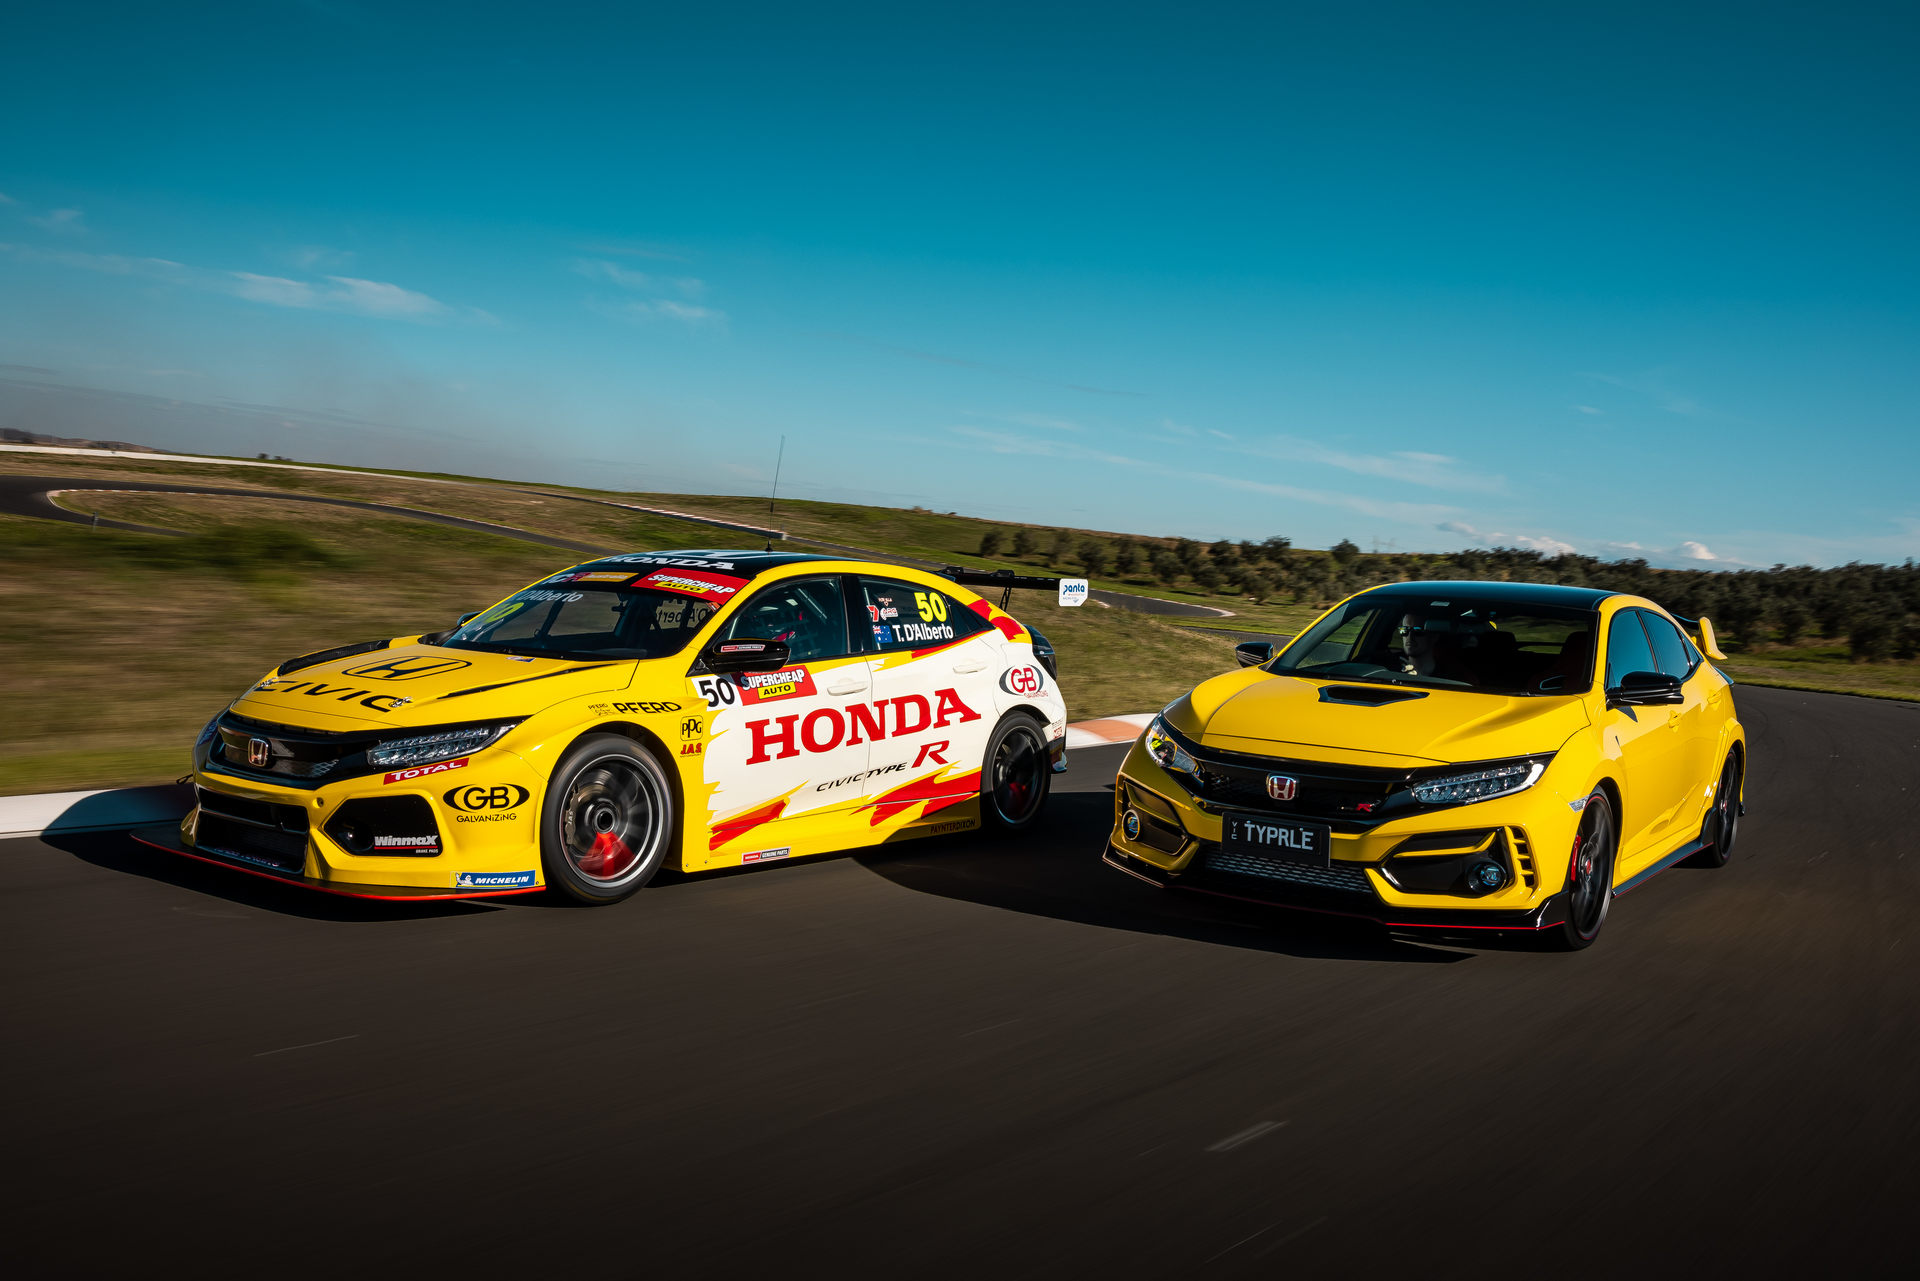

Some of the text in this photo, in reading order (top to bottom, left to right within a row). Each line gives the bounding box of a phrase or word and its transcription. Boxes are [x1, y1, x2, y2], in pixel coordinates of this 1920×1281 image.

[601, 556, 735, 570] HONDA
[648, 574, 736, 594] SUPERCHEAP
[663, 583, 702, 592] AUTO
[914, 592, 947, 622] 50
[892, 623, 954, 642] T. D'Alberto
[741, 669, 805, 690] SUPERCHEAP
[1011, 668, 1037, 693] GB
[254, 680, 412, 713] CIVIC
[699, 678, 735, 707] 50
[763, 685, 791, 696] AUTO
[612, 702, 682, 713] PFERD
[745, 687, 982, 766] HONDA
[680, 743, 702, 755] JAS
[391, 762, 462, 781] TOTAL
[816, 740, 950, 792] CIVIC TYPE R
[464, 786, 510, 810] GB
[1244, 822, 1314, 851] TYPRLE
[475, 875, 530, 885] MICHELIN
